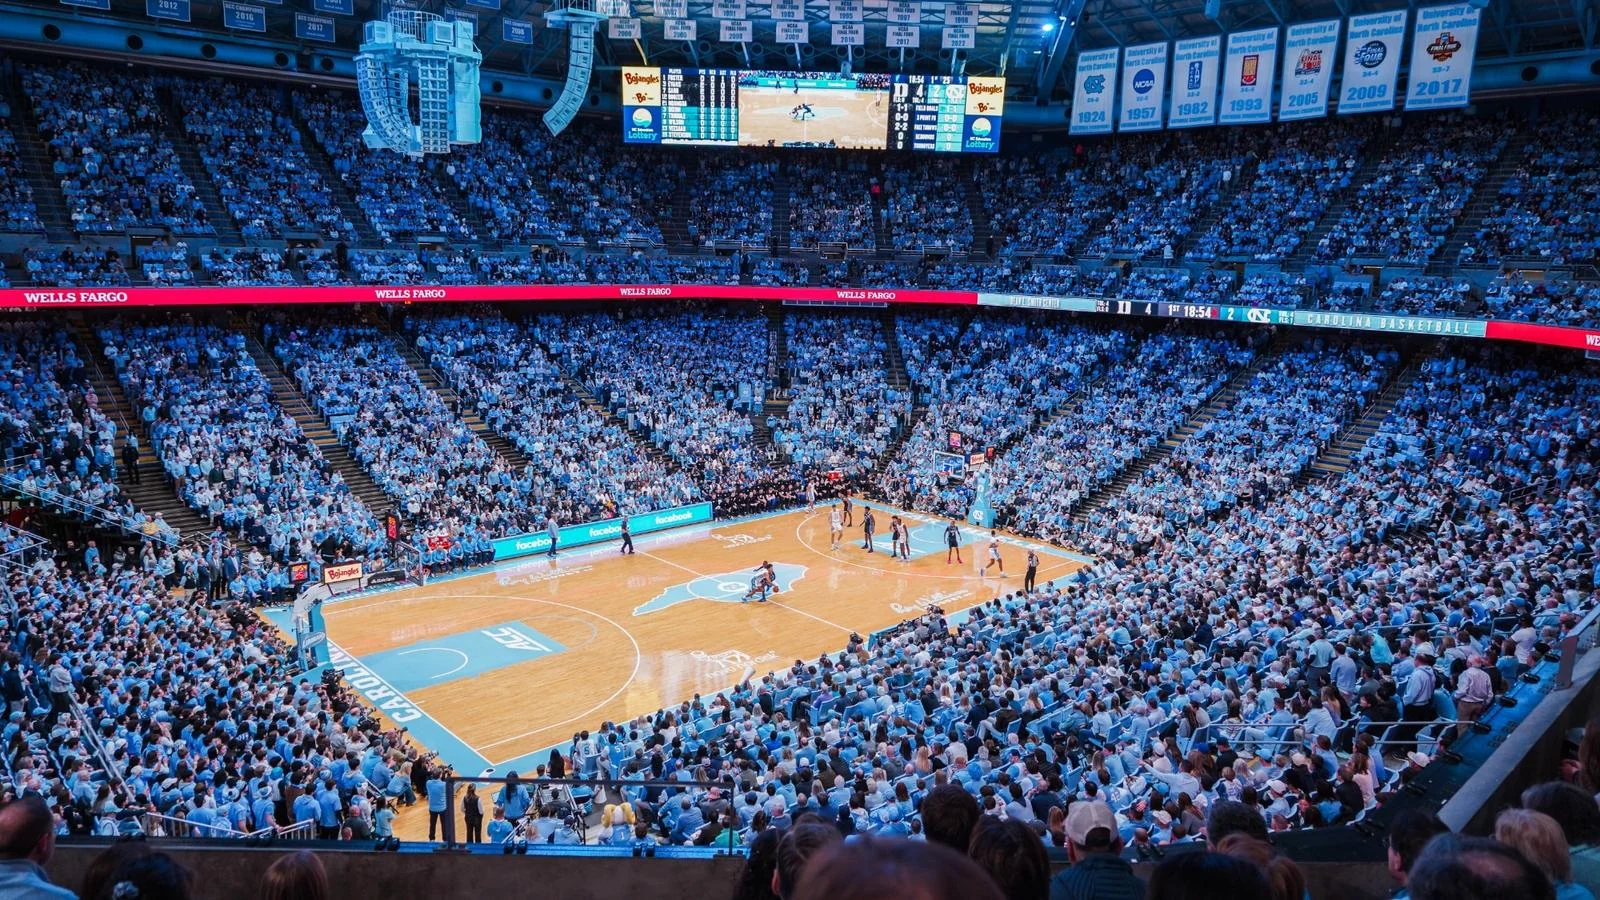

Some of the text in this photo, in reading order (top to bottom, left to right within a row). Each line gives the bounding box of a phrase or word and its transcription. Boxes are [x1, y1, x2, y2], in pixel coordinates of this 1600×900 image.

[236, 12, 254, 21] 2016
[1423, 8, 1464, 20] University
[308, 23, 323, 31] 2017
[1354, 15, 1392, 27] University
[1417, 19, 1477, 32] North Carolina
[1349, 25, 1403, 39] North Carolina
[1360, 52, 1383, 60] FOUR
[624, 72, 659, 84] Bojangles
[909, 75, 924, 84] 18:54
[1134, 80, 1154, 88] NCAA
[916, 84, 923, 97] 4
[969, 82, 1002, 94] Bojangles
[1347, 84, 1387, 100] 2009
[1415, 79, 1462, 96] 2017
[1230, 98, 1262, 111] 1993
[1288, 92, 1318, 107] 2005
[1127, 107, 1156, 120] 1957
[1177, 101, 1208, 115] 1982
[895, 113, 909, 121] 0-0
[1078, 111, 1105, 123] 1924
[895, 122, 908, 131] 2-2
[628, 131, 658, 140] Lottery
[898, 132, 904, 140] 0
[897, 141, 903, 149] 0
[966, 141, 995, 150] Lottery
[24, 292, 128, 304] WELLS FARGO
[375, 288, 446, 299] WELLS FARGO
[837, 291, 865, 300] WELLS
[1145, 303, 1151, 314] 4
[1168, 304, 1211, 318] 1ST 18:54
[1228, 308, 1234, 320] 2
[1307, 314, 1470, 334] CAROLINA BASKETBALL
[656, 512, 692, 524] facebook
[328, 567, 359, 580] Bojangles
[481, 627, 542, 650] ACC
